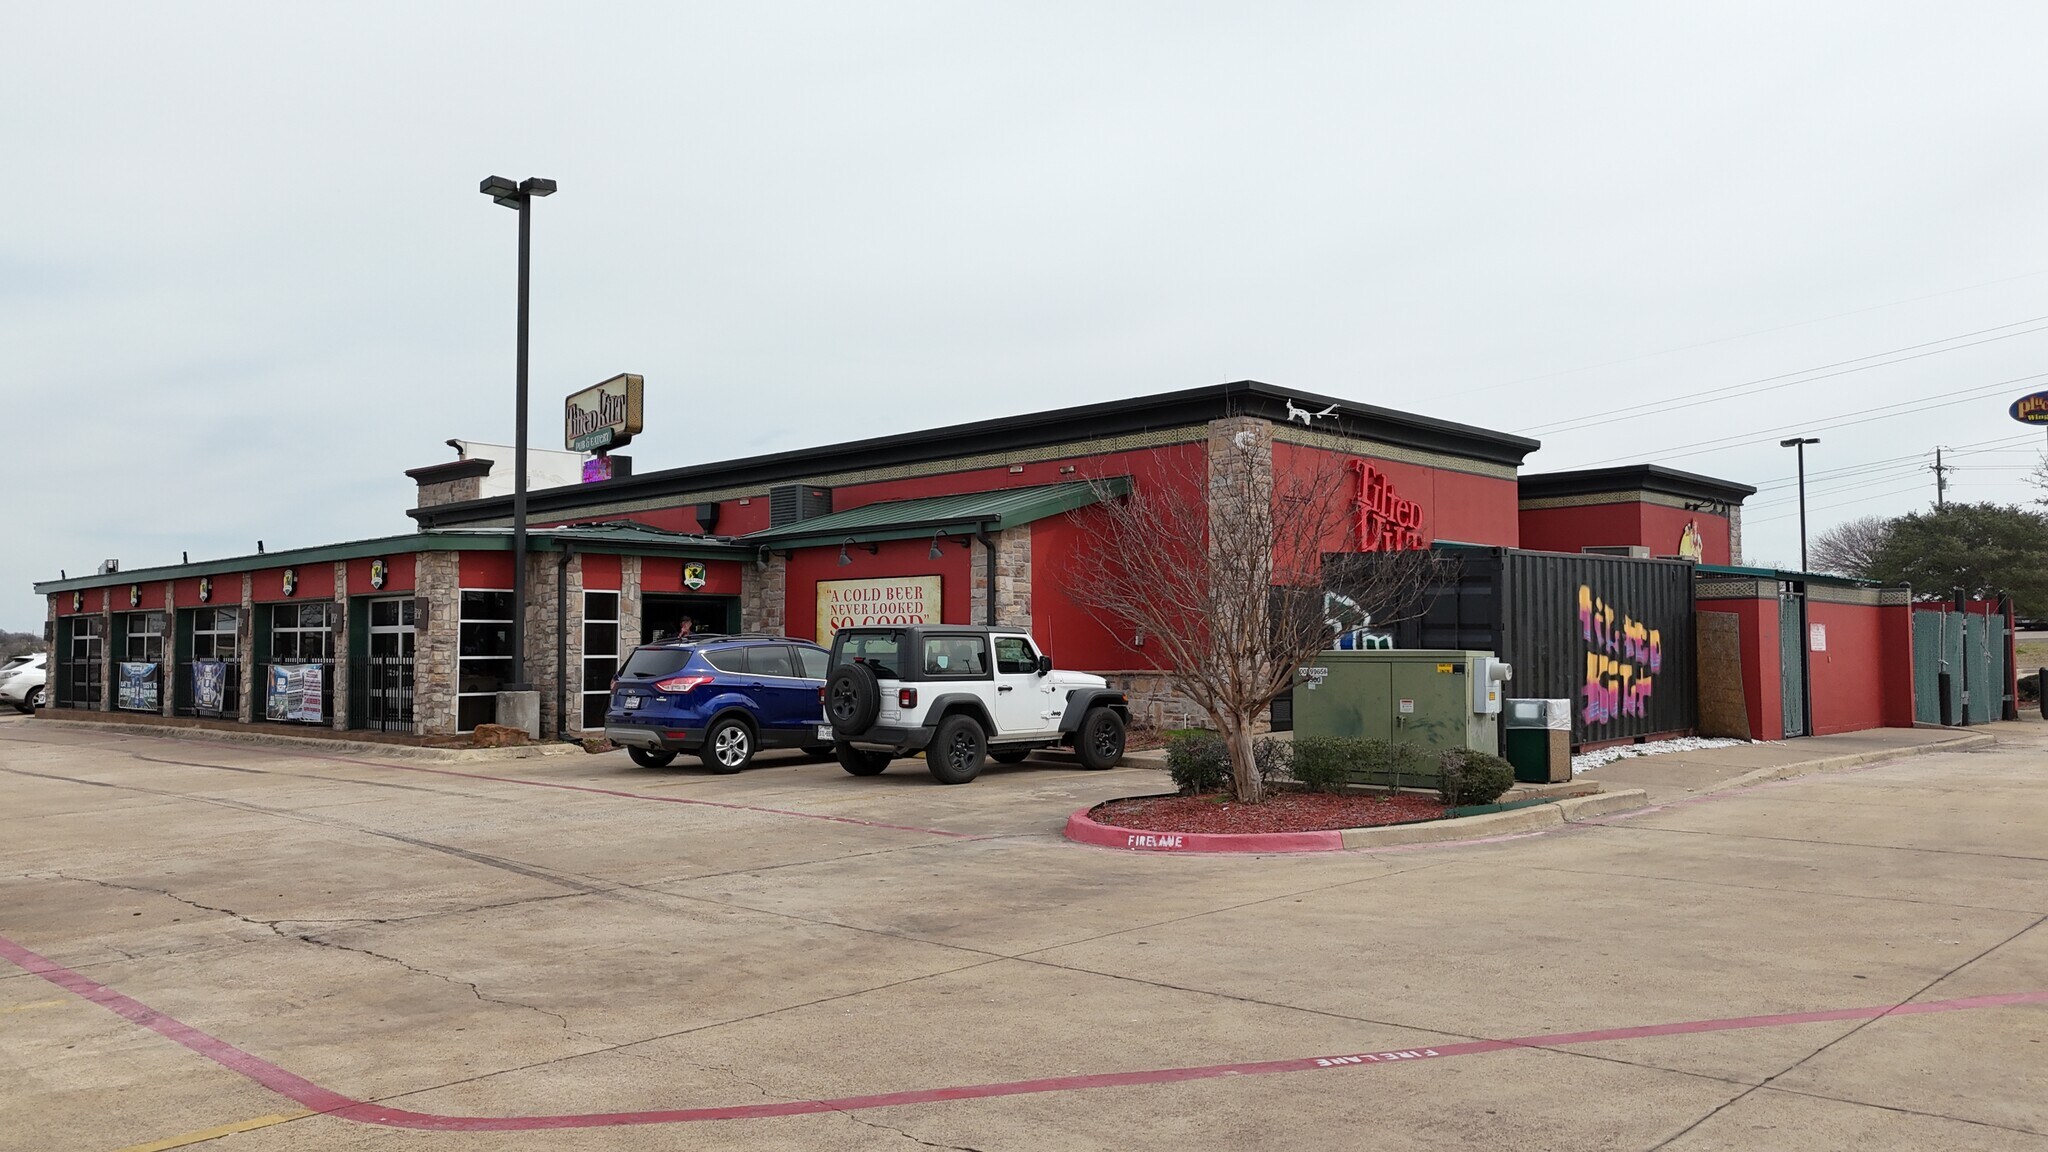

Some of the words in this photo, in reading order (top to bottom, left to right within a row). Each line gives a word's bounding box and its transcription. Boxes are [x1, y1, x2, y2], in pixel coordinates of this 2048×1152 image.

[843, 588, 881, 602] COLD
[886, 586, 923, 600] BEER
[830, 603, 868, 616] NEVER
[872, 602, 924, 615] LOOKED
[1315, 1054, 1380, 1067] LANE
[1380, 1049, 1439, 1060] FIRE
